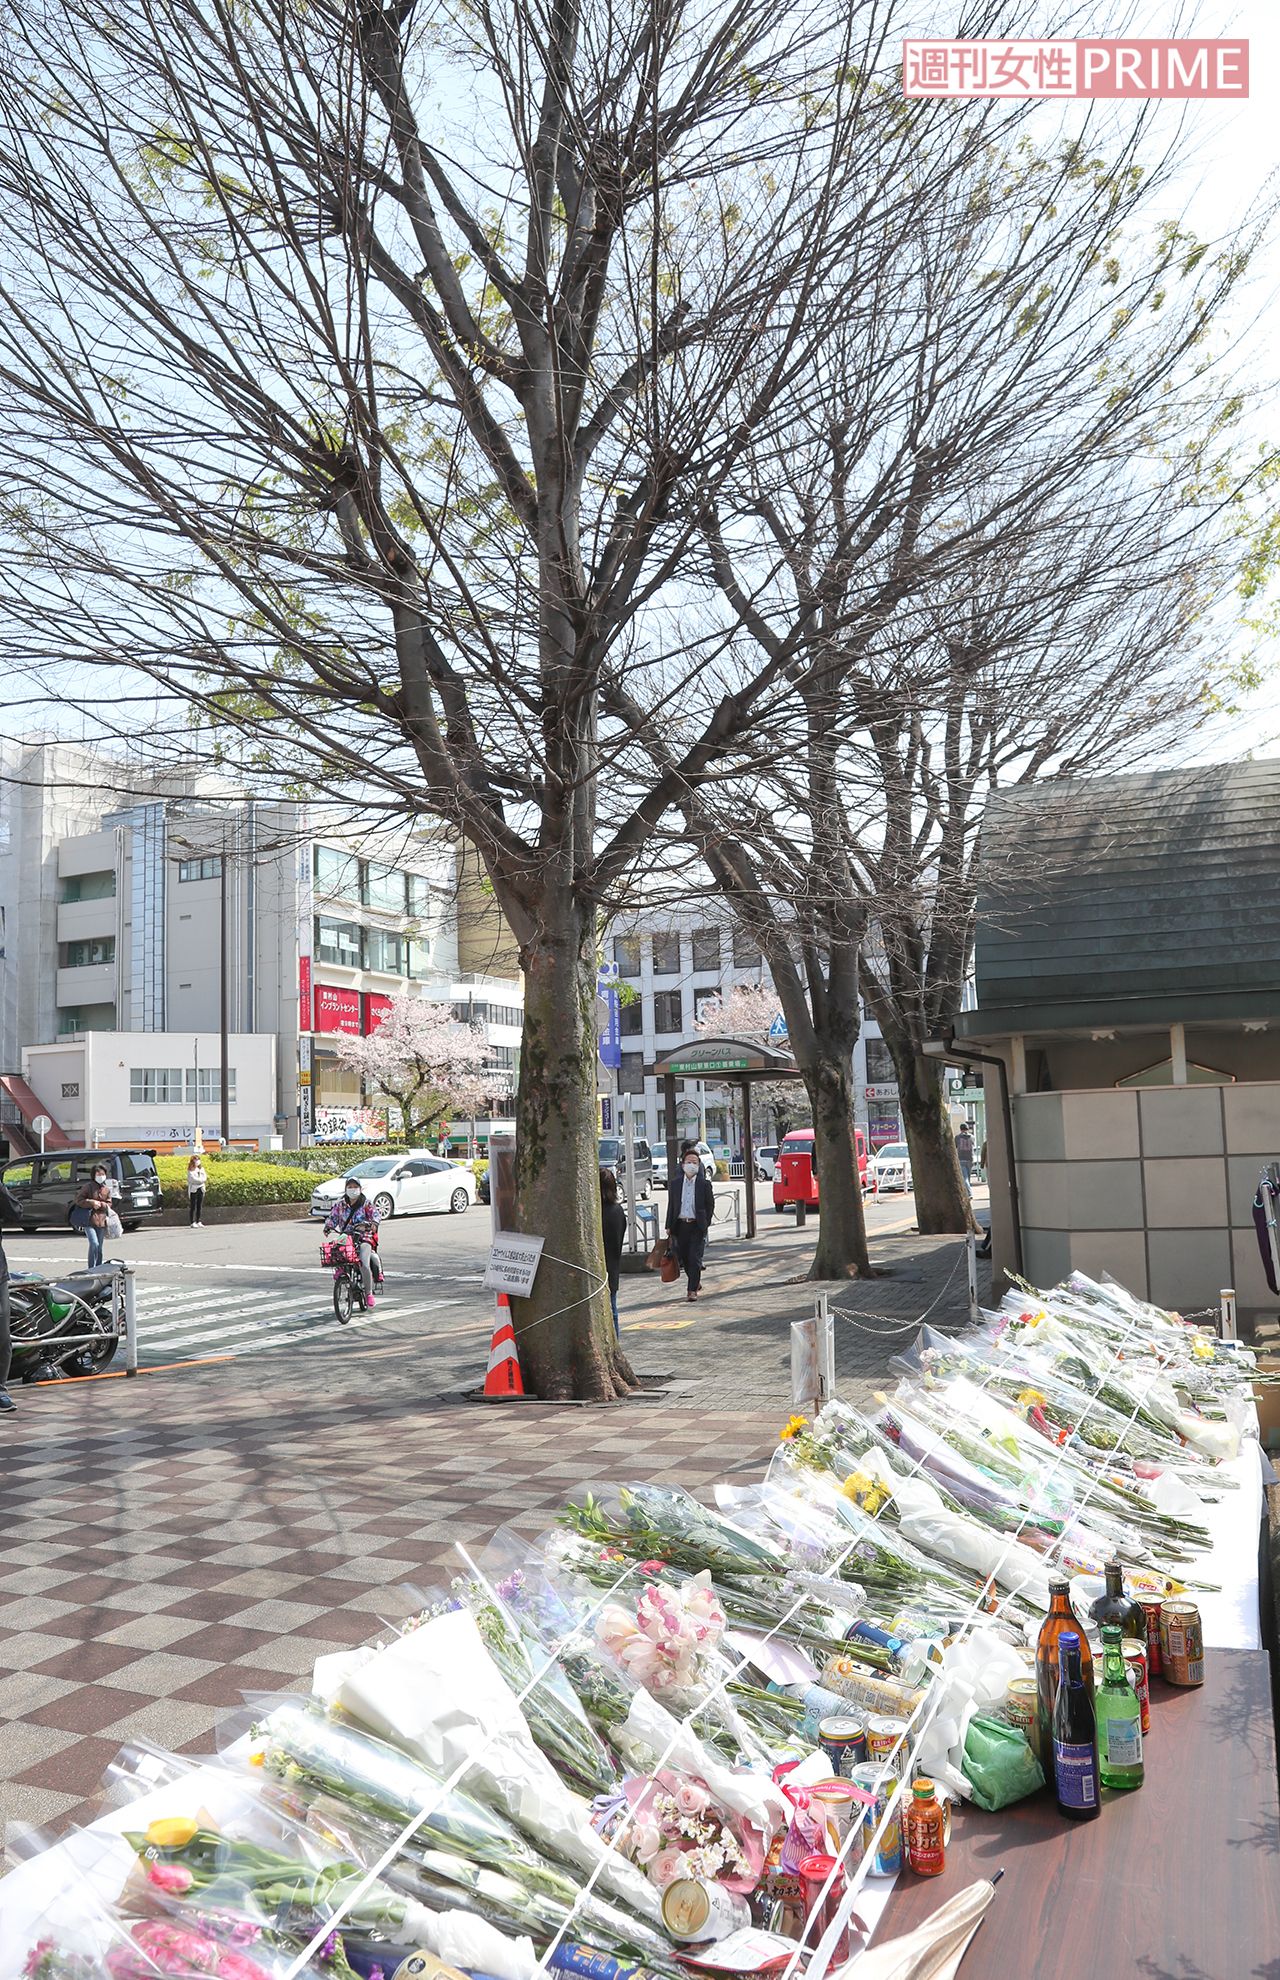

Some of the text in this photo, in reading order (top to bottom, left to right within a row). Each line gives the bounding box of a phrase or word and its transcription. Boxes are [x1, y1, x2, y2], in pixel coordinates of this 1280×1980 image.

[320, 1001, 358, 1013] インプラントセンター
[691, 1048, 731, 1057] グリーンバス
[871, 1123, 897, 1131] フリーローン
[169, 1128, 204, 1138] ふじ
[908, 1820, 940, 1835] ウコン
